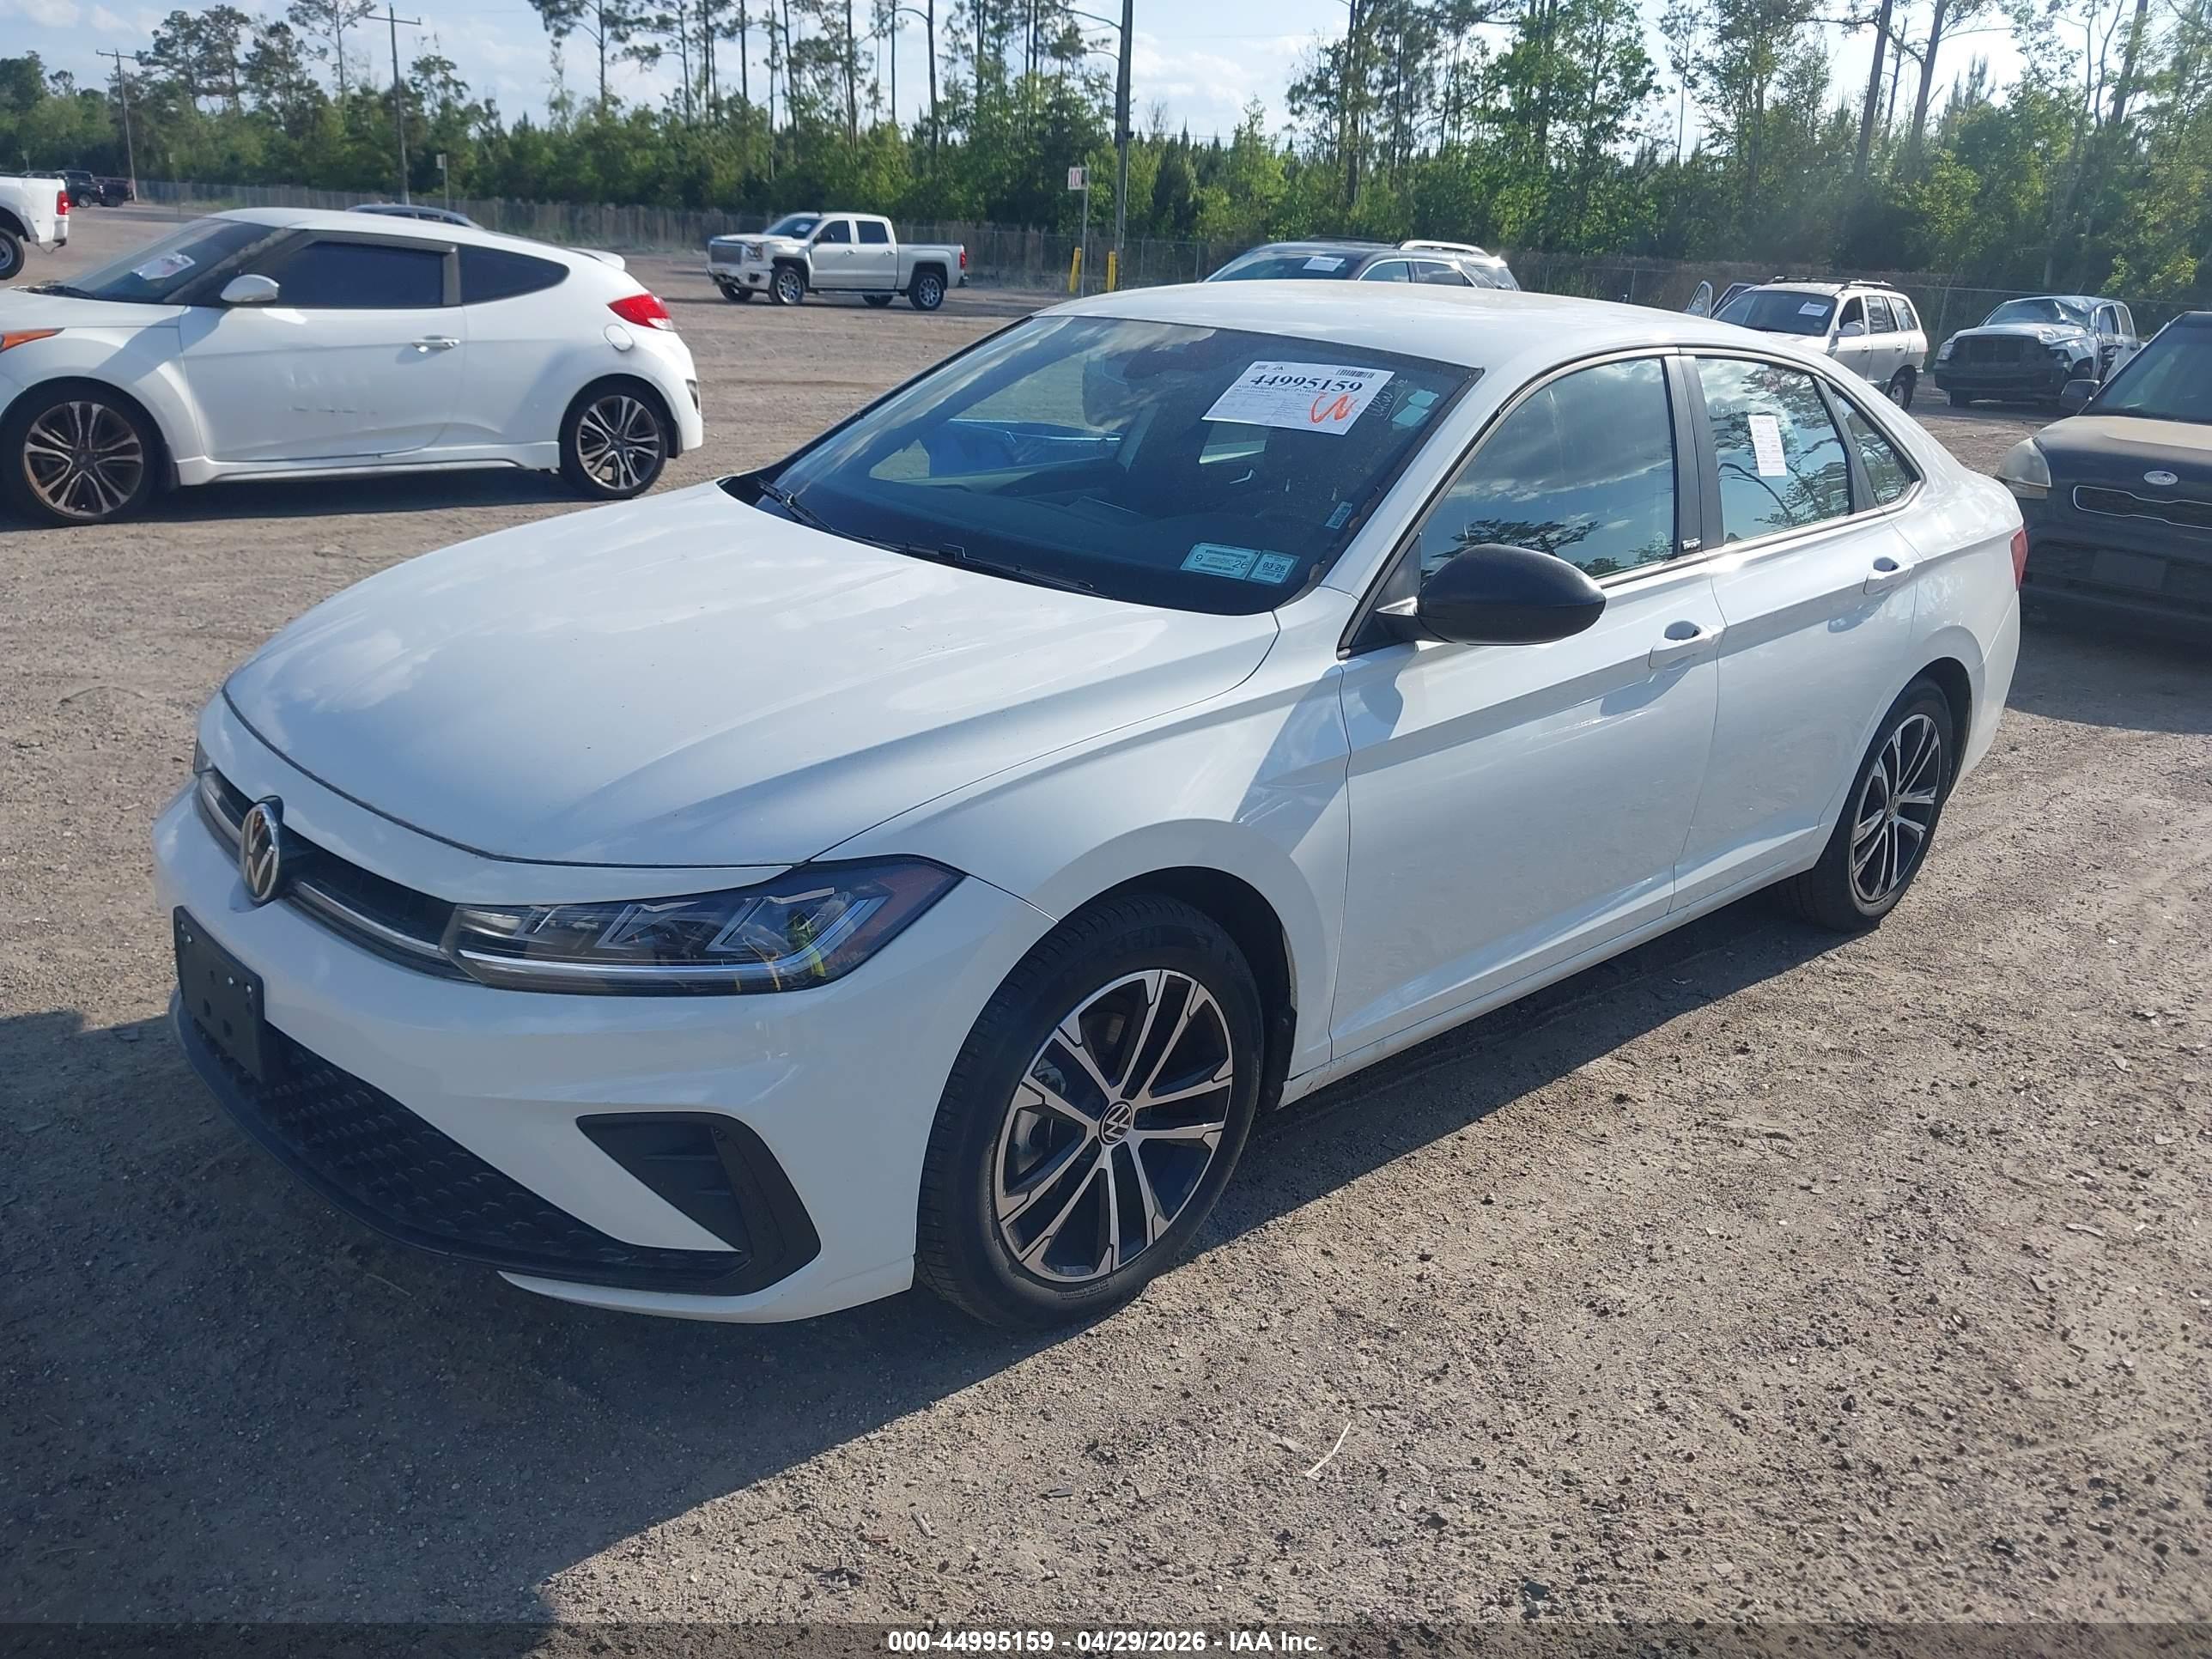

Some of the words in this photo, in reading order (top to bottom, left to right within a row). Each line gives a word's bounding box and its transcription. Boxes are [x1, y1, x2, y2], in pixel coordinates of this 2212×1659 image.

[1071, 170, 1081, 187] 10
[1250, 374, 1364, 393] 44995159
[1194, 554, 1204, 562] 9
[1231, 560, 1251, 569] 26
